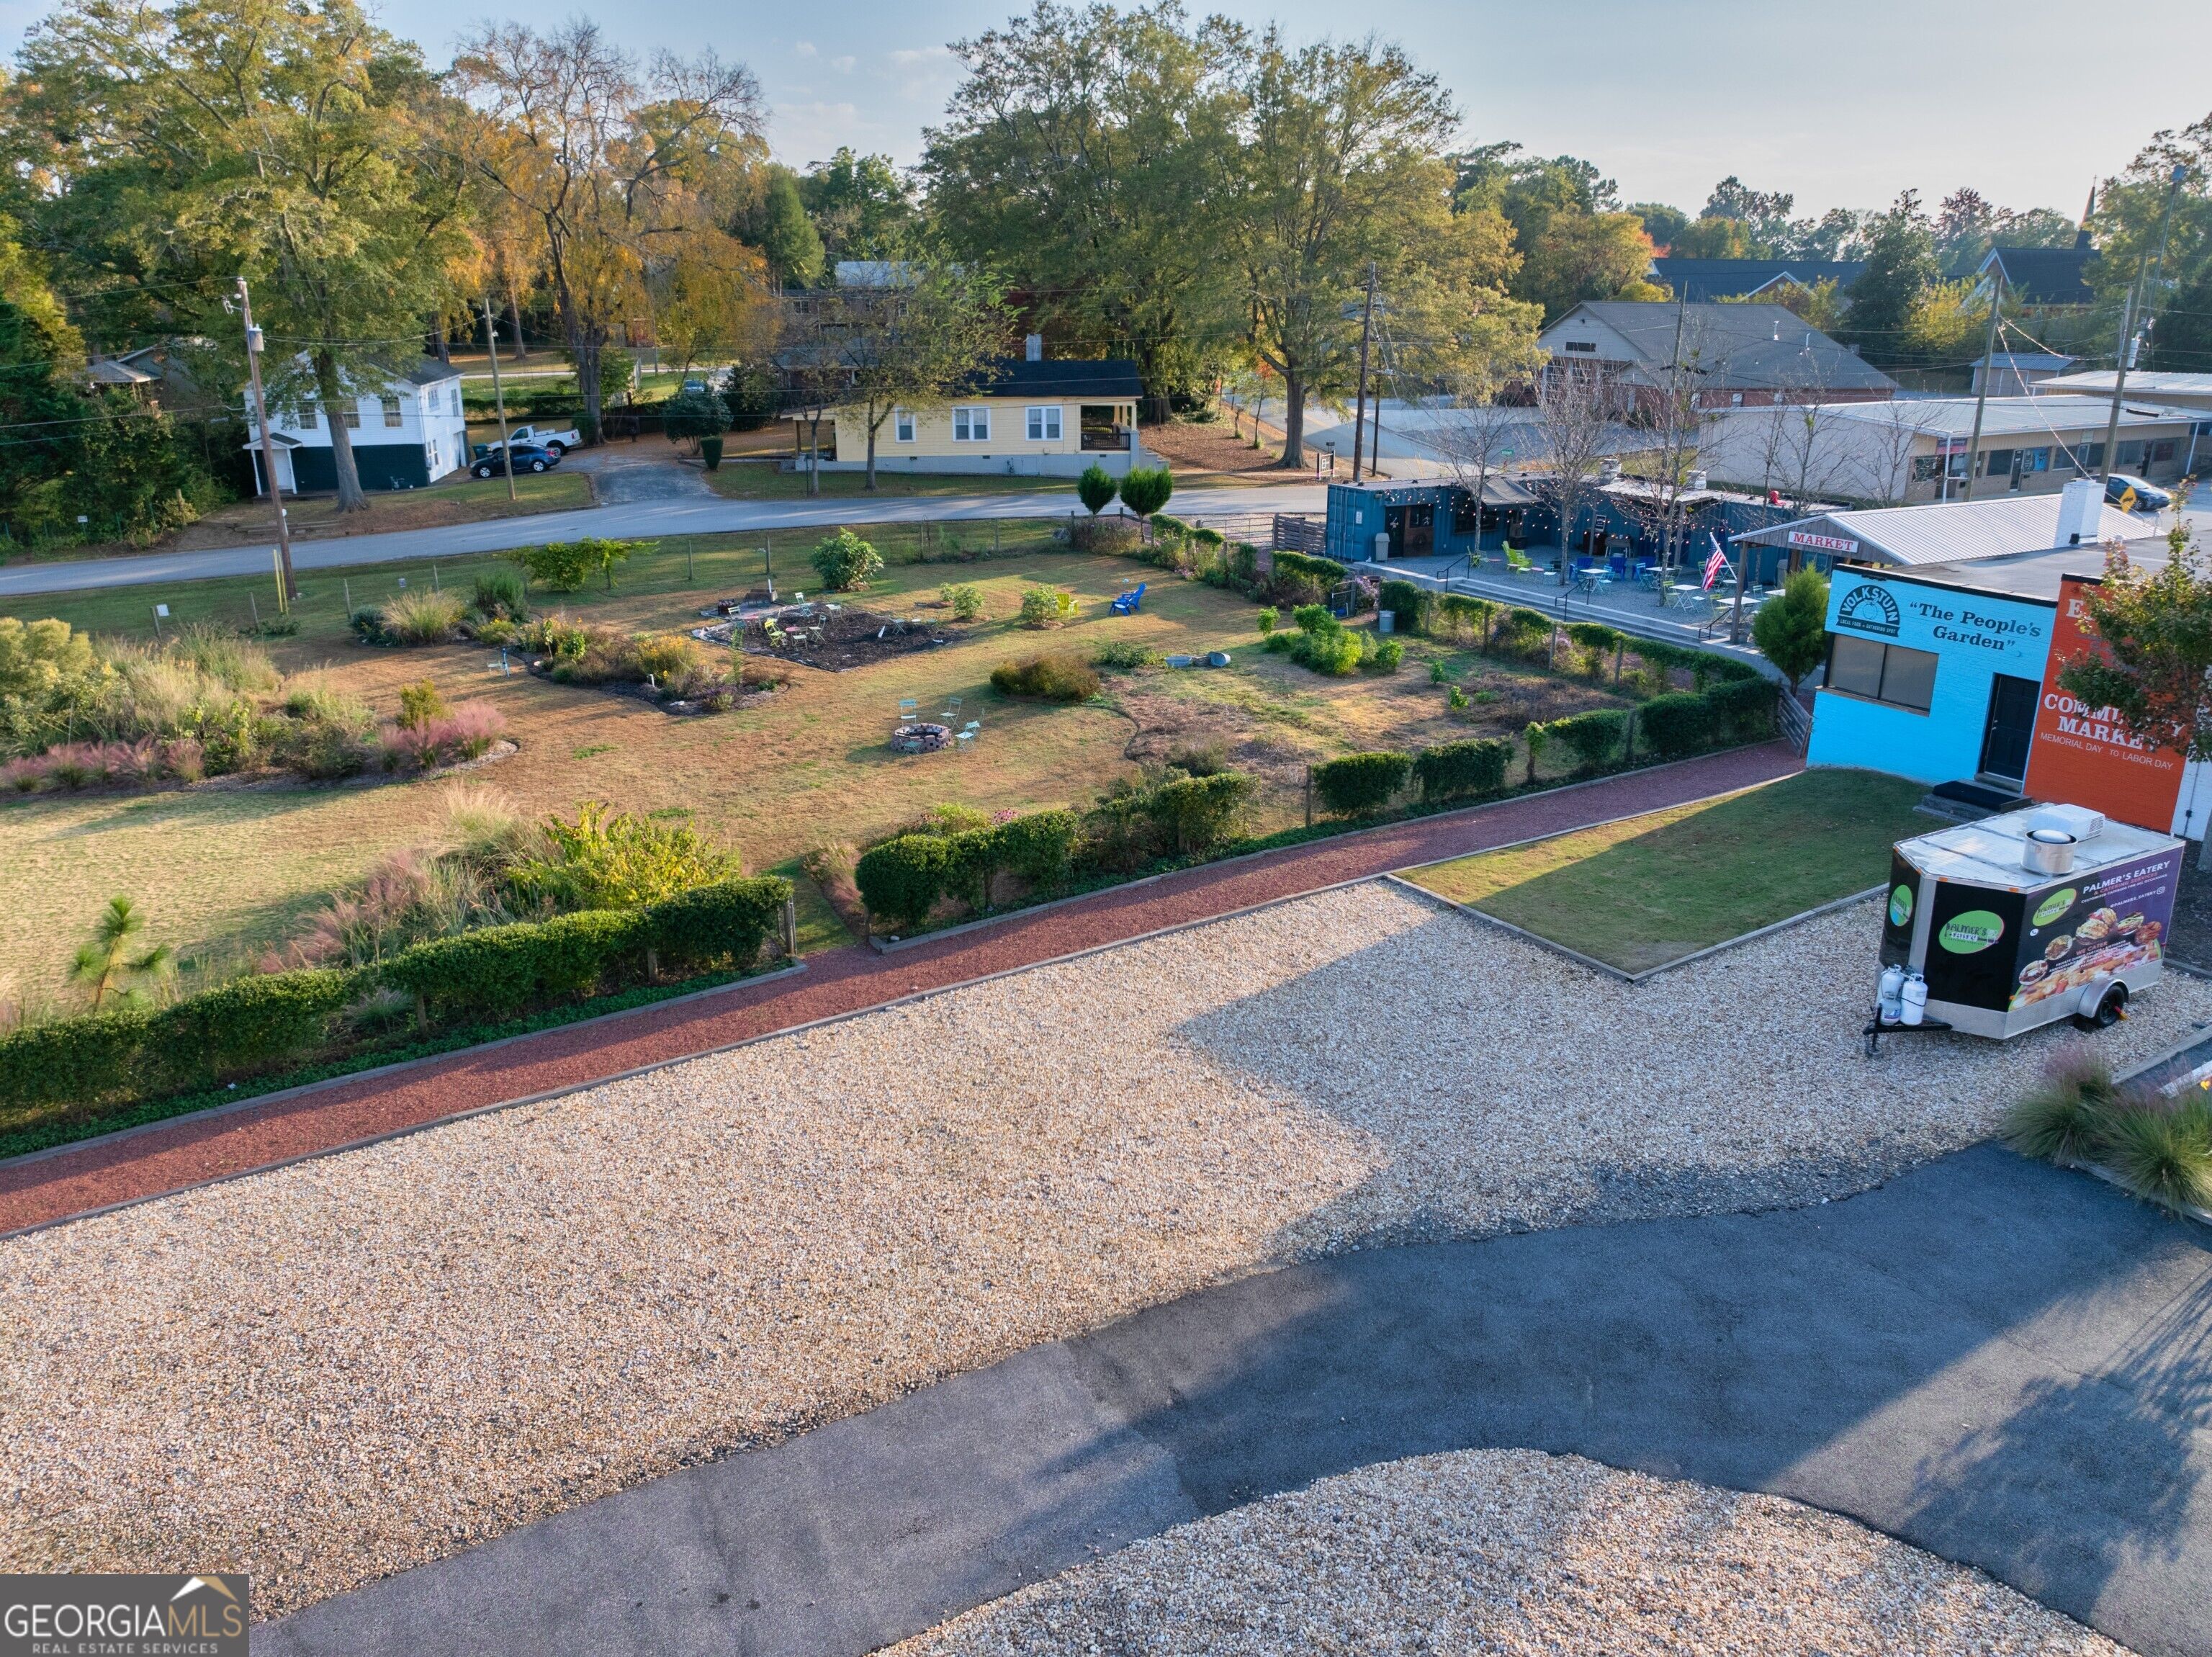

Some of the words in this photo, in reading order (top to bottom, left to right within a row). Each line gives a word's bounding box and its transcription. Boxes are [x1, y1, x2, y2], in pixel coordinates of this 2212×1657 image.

[1793, 533, 1853, 551] MARKET
[1841, 587, 1898, 621] VOLKSTUIN
[2057, 715, 2160, 751] MARKE
[2040, 732, 2084, 750] MEMORIAL
[2085, 743, 2103, 754] DAY
[2122, 751, 2152, 766] LABOR
[2154, 759, 2174, 771] DAY
[2082, 873, 2132, 894] PALMER'S
[2134, 861, 2171, 878] EATERY
